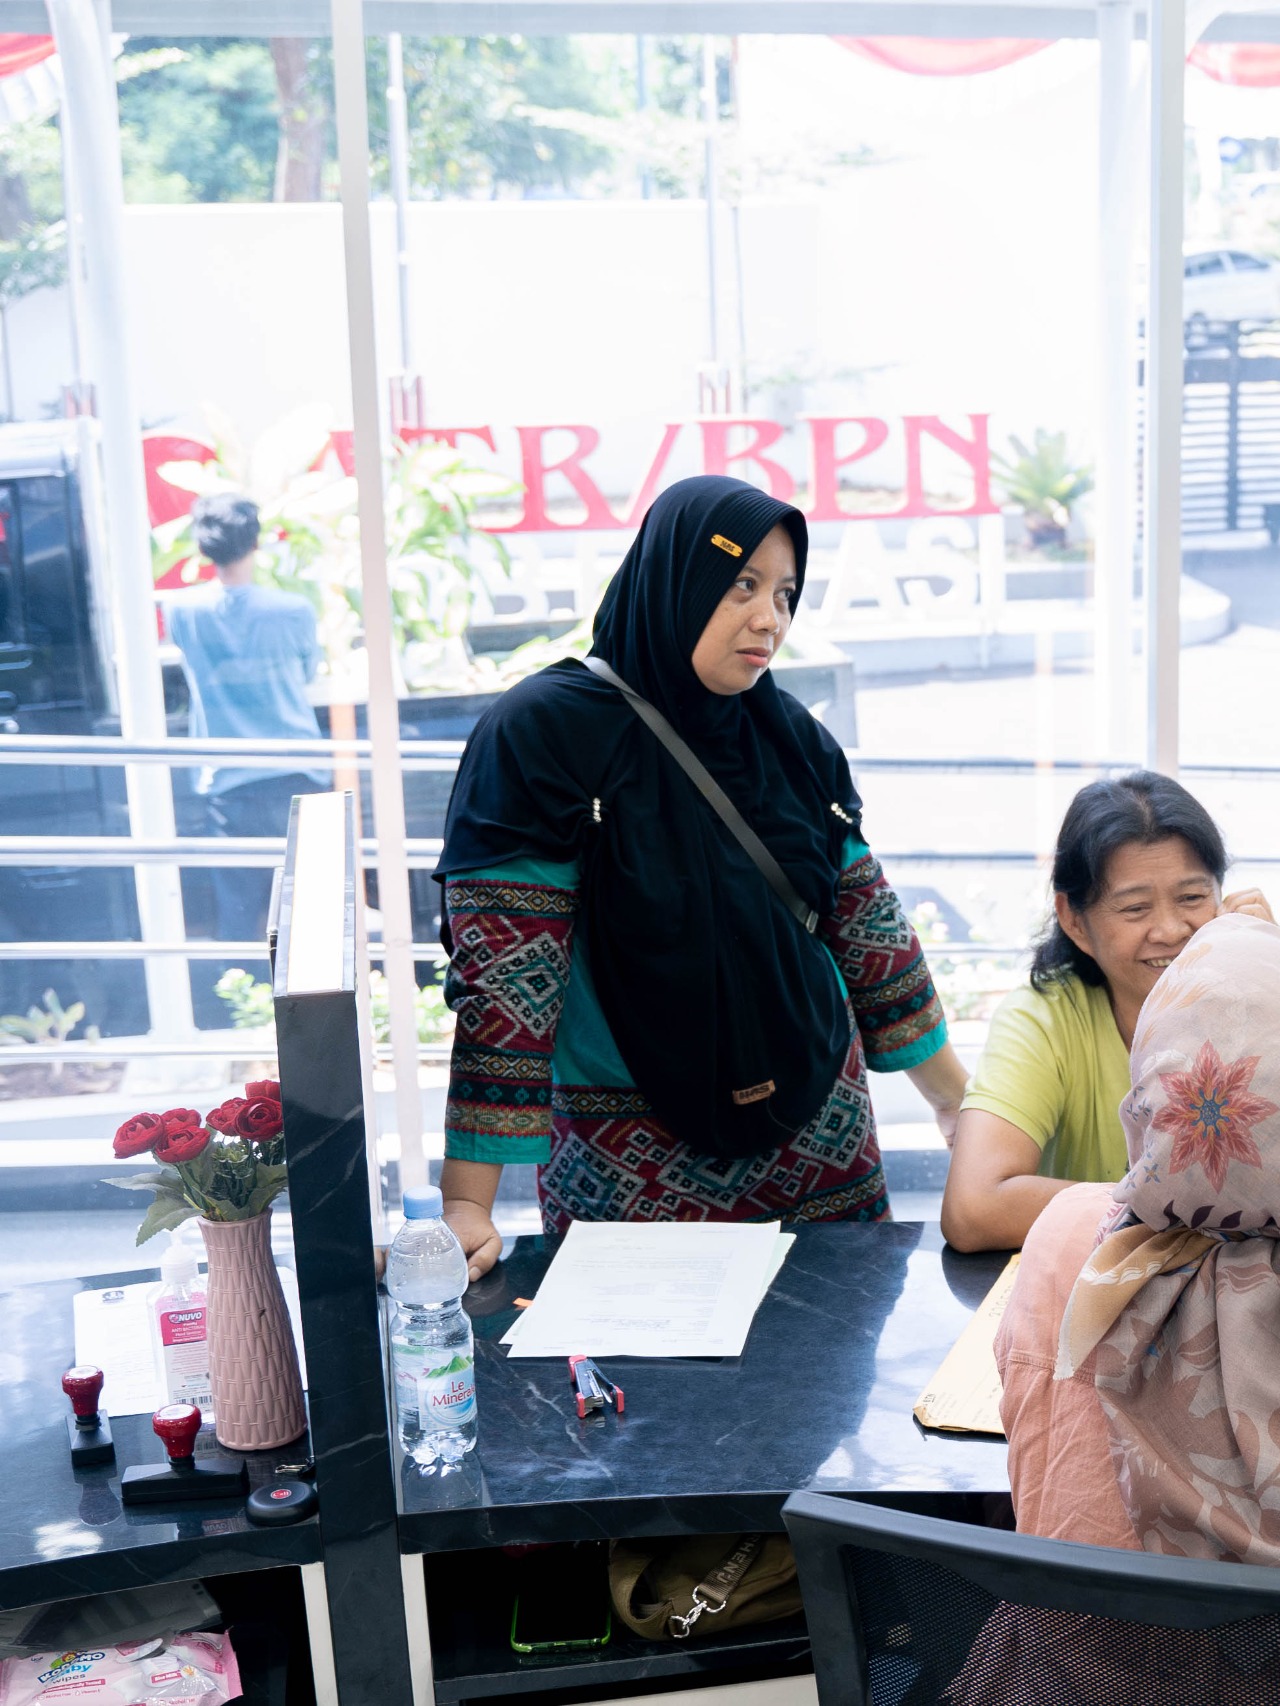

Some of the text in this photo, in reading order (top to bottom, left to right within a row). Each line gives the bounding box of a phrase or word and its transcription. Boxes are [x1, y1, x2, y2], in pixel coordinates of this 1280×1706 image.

[178, 1311, 202, 1322] NUVO
[451, 1381, 464, 1393] Le
[52, 1673, 86, 1685] wipes
